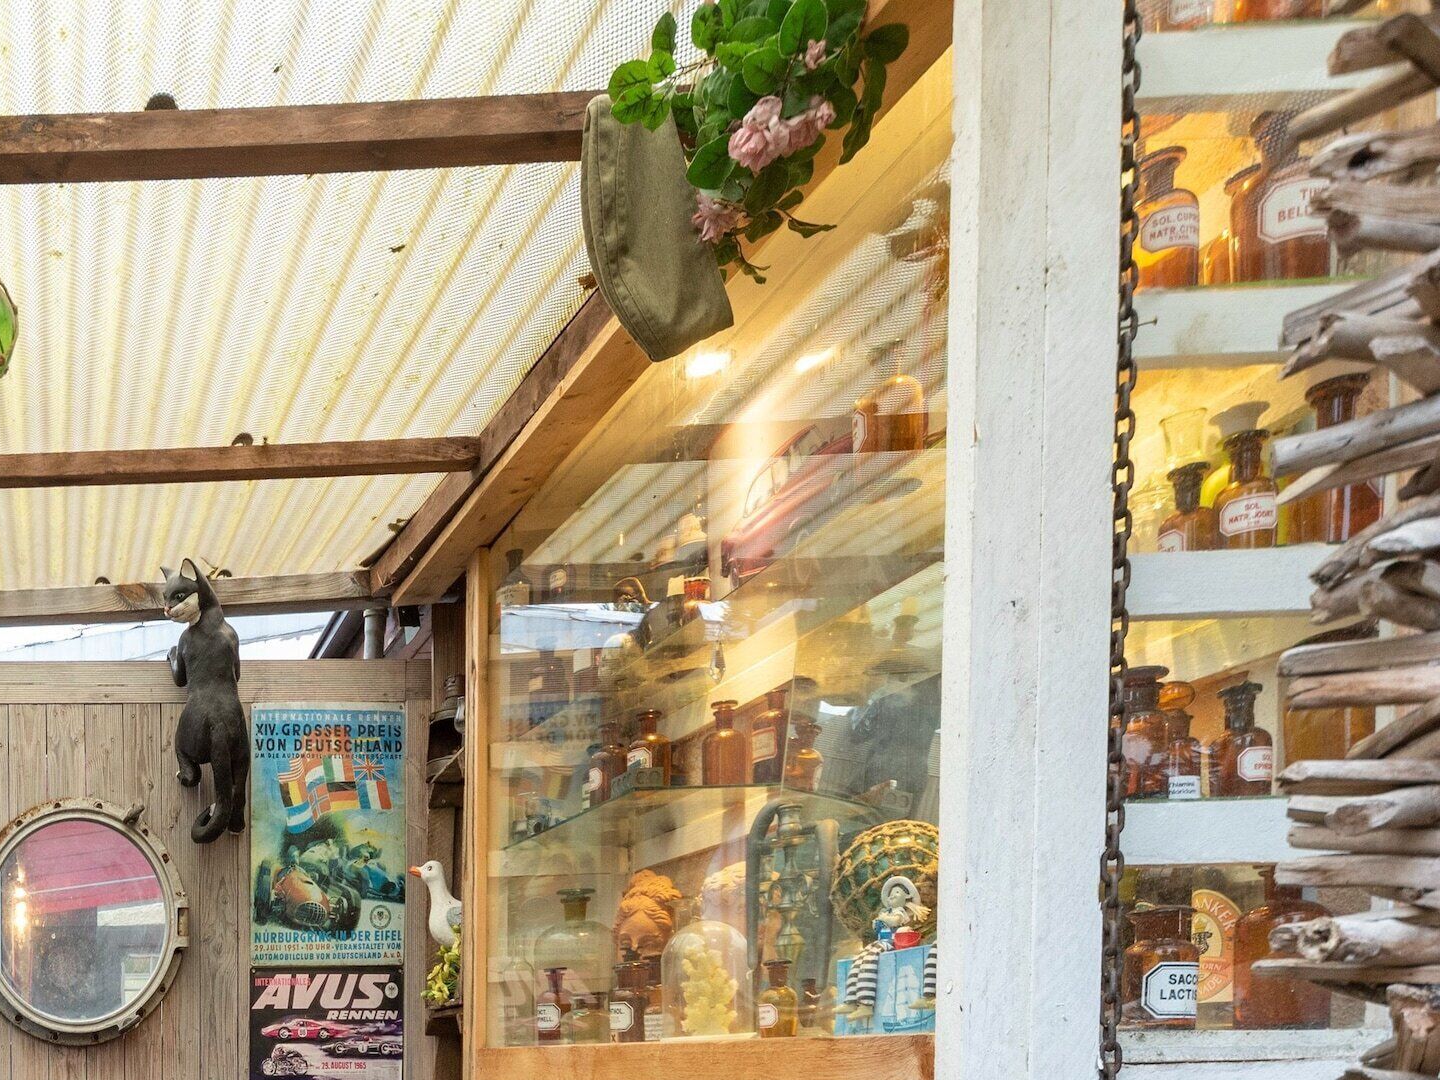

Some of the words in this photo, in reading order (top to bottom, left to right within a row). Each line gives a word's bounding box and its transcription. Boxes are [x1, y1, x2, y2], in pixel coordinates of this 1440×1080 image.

[254, 713, 352, 722] INTERNATIONALE
[255, 723, 278, 737] XIV.
[282, 723, 352, 738] GROSSER
[358, 724, 402, 738] PREIS
[255, 738, 286, 752] VON
[294, 739, 403, 753] DEUTSCHLAND
[254, 929, 332, 944] NÜRBURGRING
[336, 931, 348, 942] IN
[350, 930, 371, 942] DER
[374, 930, 402, 942] EIFEL
[335, 943, 384, 951] VERANSTALTET
[254, 952, 314, 961] AUTOMOBILCLUB
[316, 952, 330, 960] VON
[332, 951, 381, 960] DEUTSCHLAND
[251, 973, 391, 1010] AVUS
[326, 1010, 399, 1020] RENNEN
[331, 1061, 353, 1070] AUGUST
[354, 1061, 367, 1070] 1965
